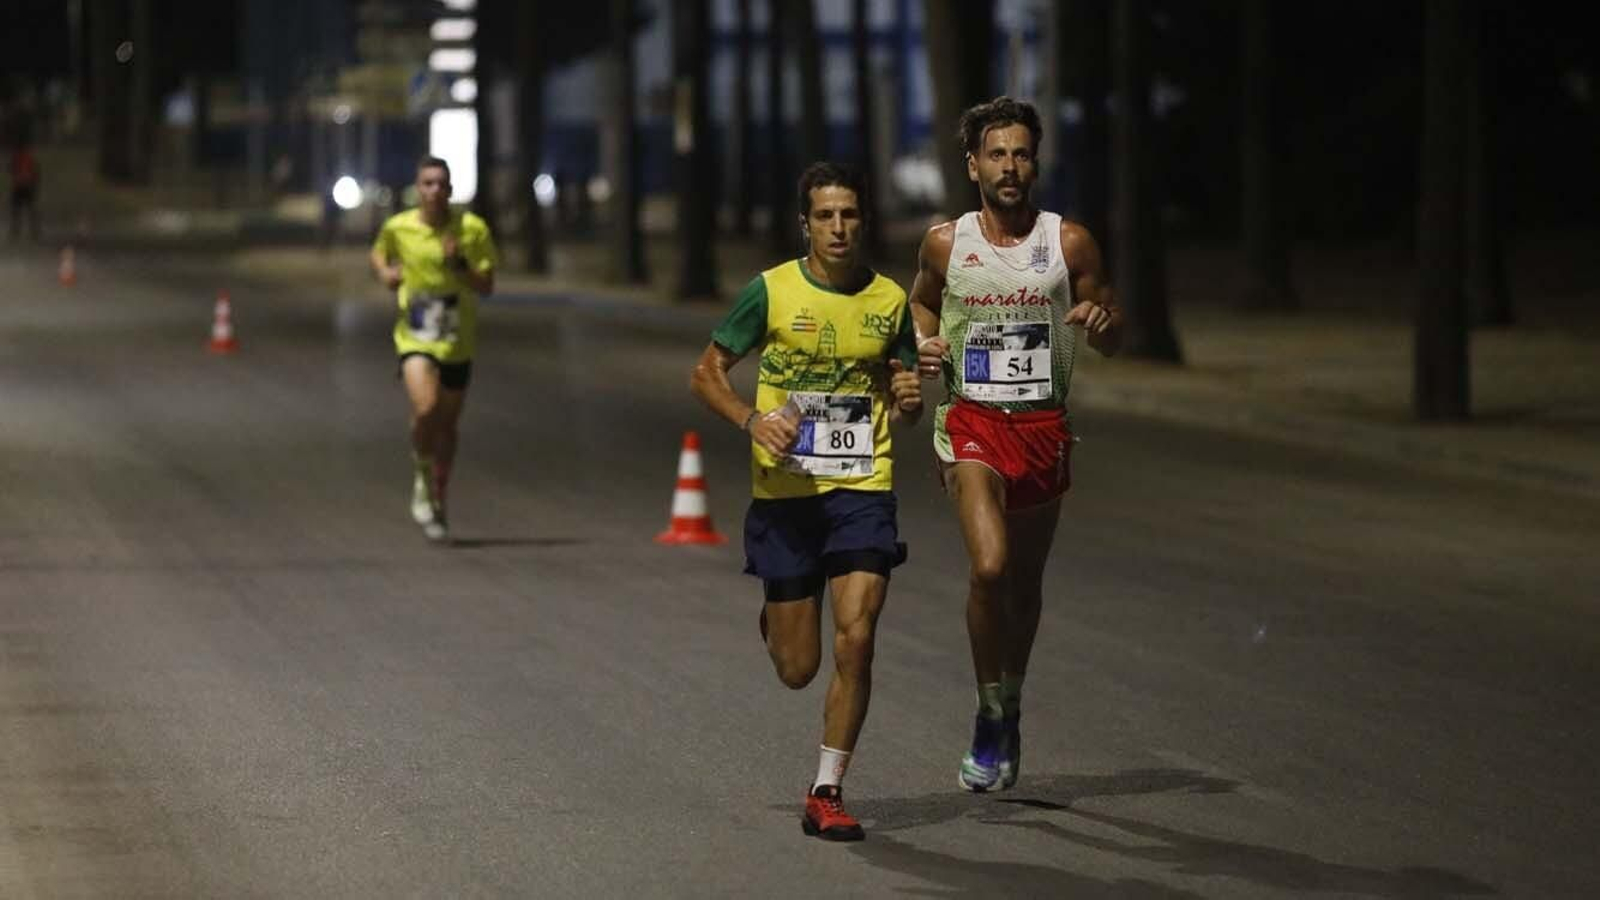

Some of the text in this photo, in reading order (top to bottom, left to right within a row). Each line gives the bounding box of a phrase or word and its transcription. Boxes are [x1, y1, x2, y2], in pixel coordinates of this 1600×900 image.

[963, 286, 1052, 307] maratón
[966, 353, 988, 378] 15K
[1007, 355, 1034, 377] 54
[830, 430, 855, 449] 80
